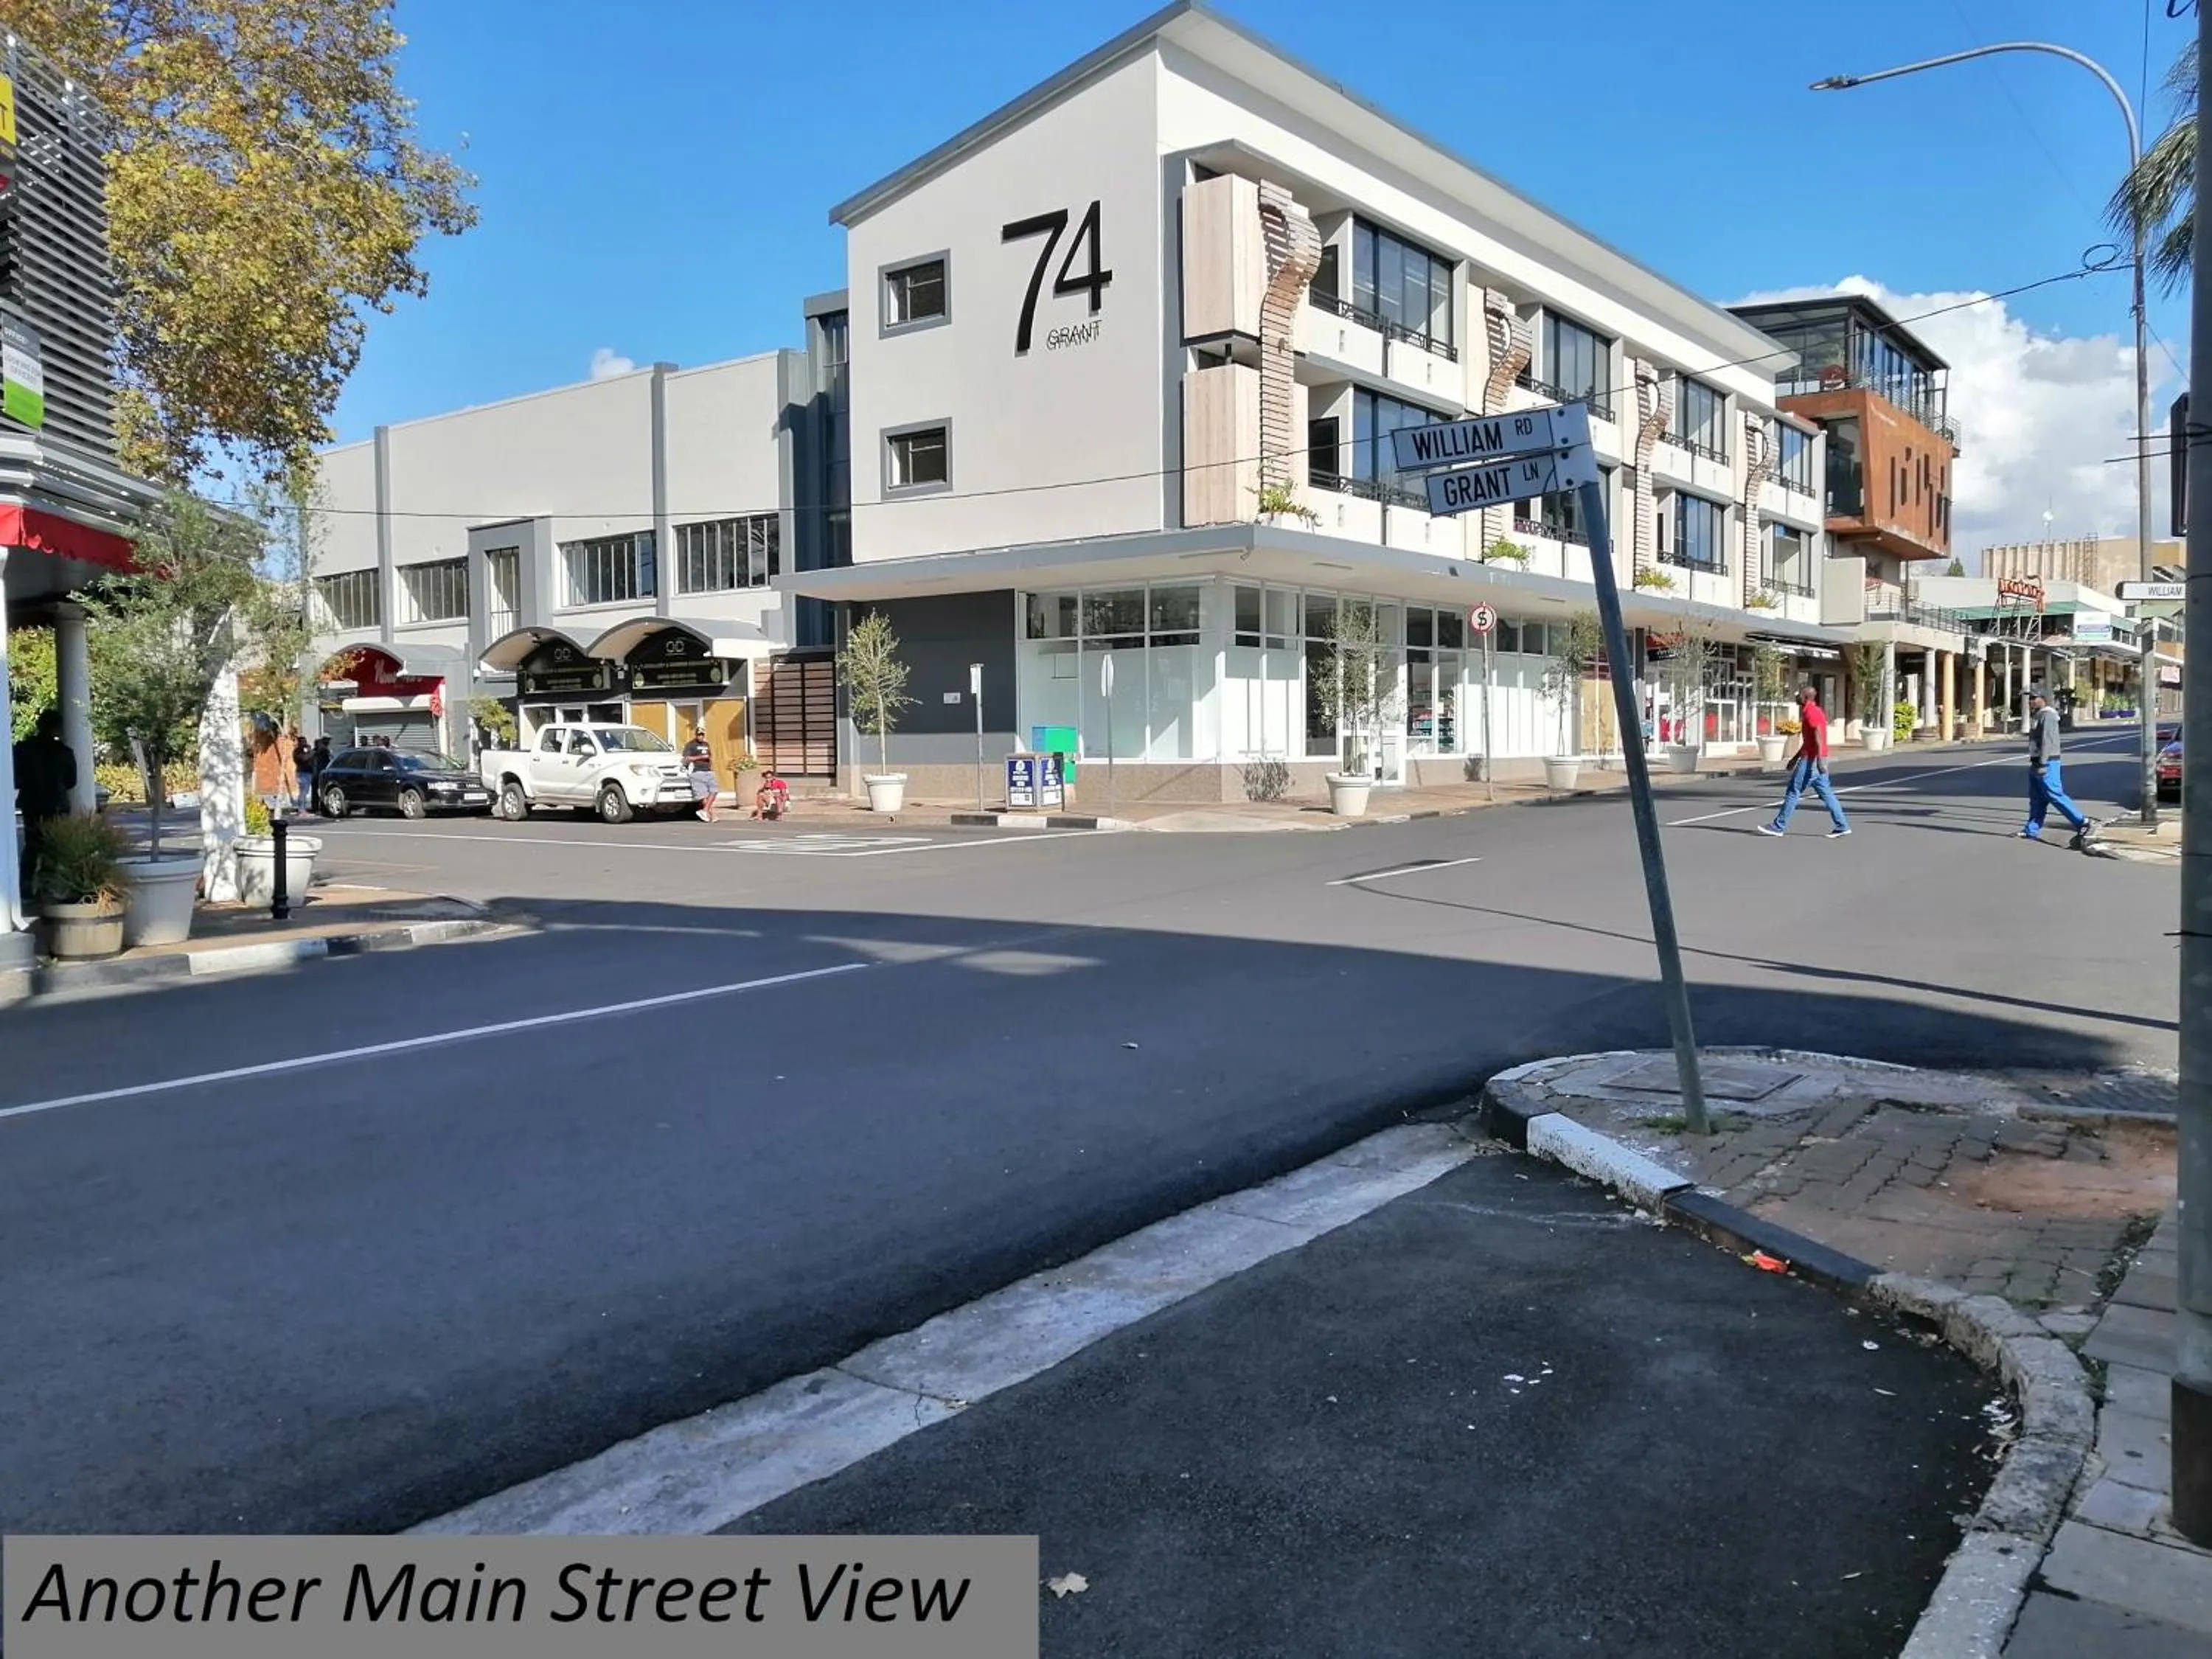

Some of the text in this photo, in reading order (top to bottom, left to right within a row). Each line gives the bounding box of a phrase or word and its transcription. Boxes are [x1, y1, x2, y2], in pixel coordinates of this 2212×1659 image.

[1001, 200, 1112, 353] 74
[1047, 319, 1102, 349] GRANT
[1412, 417, 1532, 461] WILLIAM RD
[1443, 462, 1539, 507] GRANT LN
[2147, 585, 2183, 597] WILLIAM
